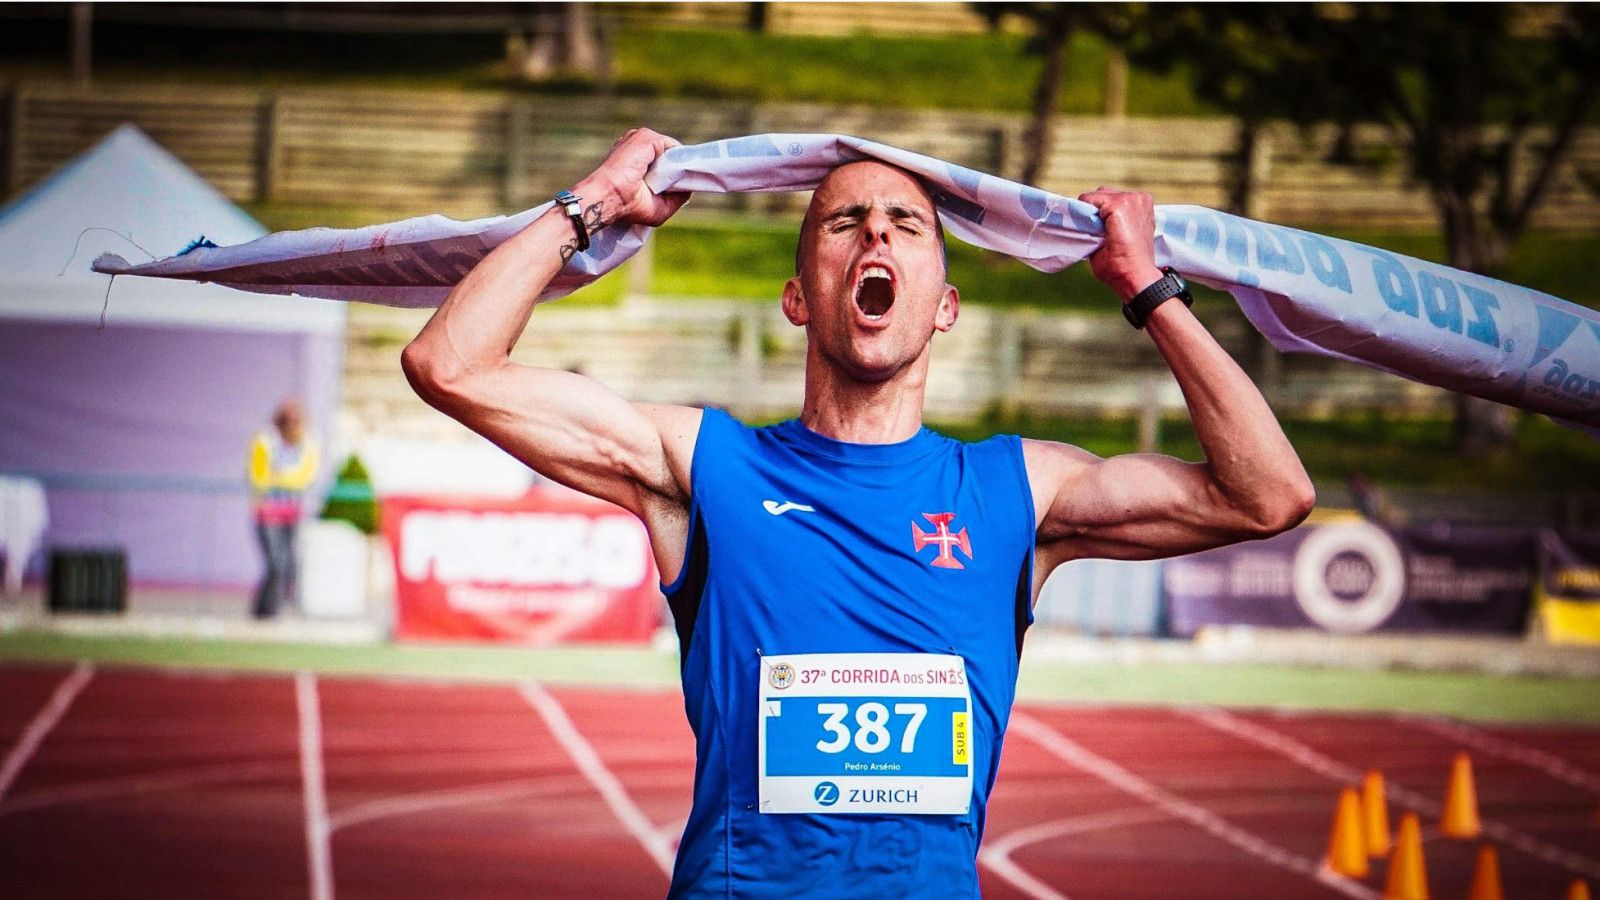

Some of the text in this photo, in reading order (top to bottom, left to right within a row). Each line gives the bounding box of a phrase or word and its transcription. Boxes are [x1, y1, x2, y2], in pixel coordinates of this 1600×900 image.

[801, 669, 826, 684] 37ª
[831, 669, 901, 684] CORRIDA
[903, 673, 924, 684] DOS
[816, 702, 928, 754] 387
[956, 731, 965, 756] SUB
[845, 762, 901, 770] Pedro Arsénio
[848, 789, 918, 803] ZURICH
